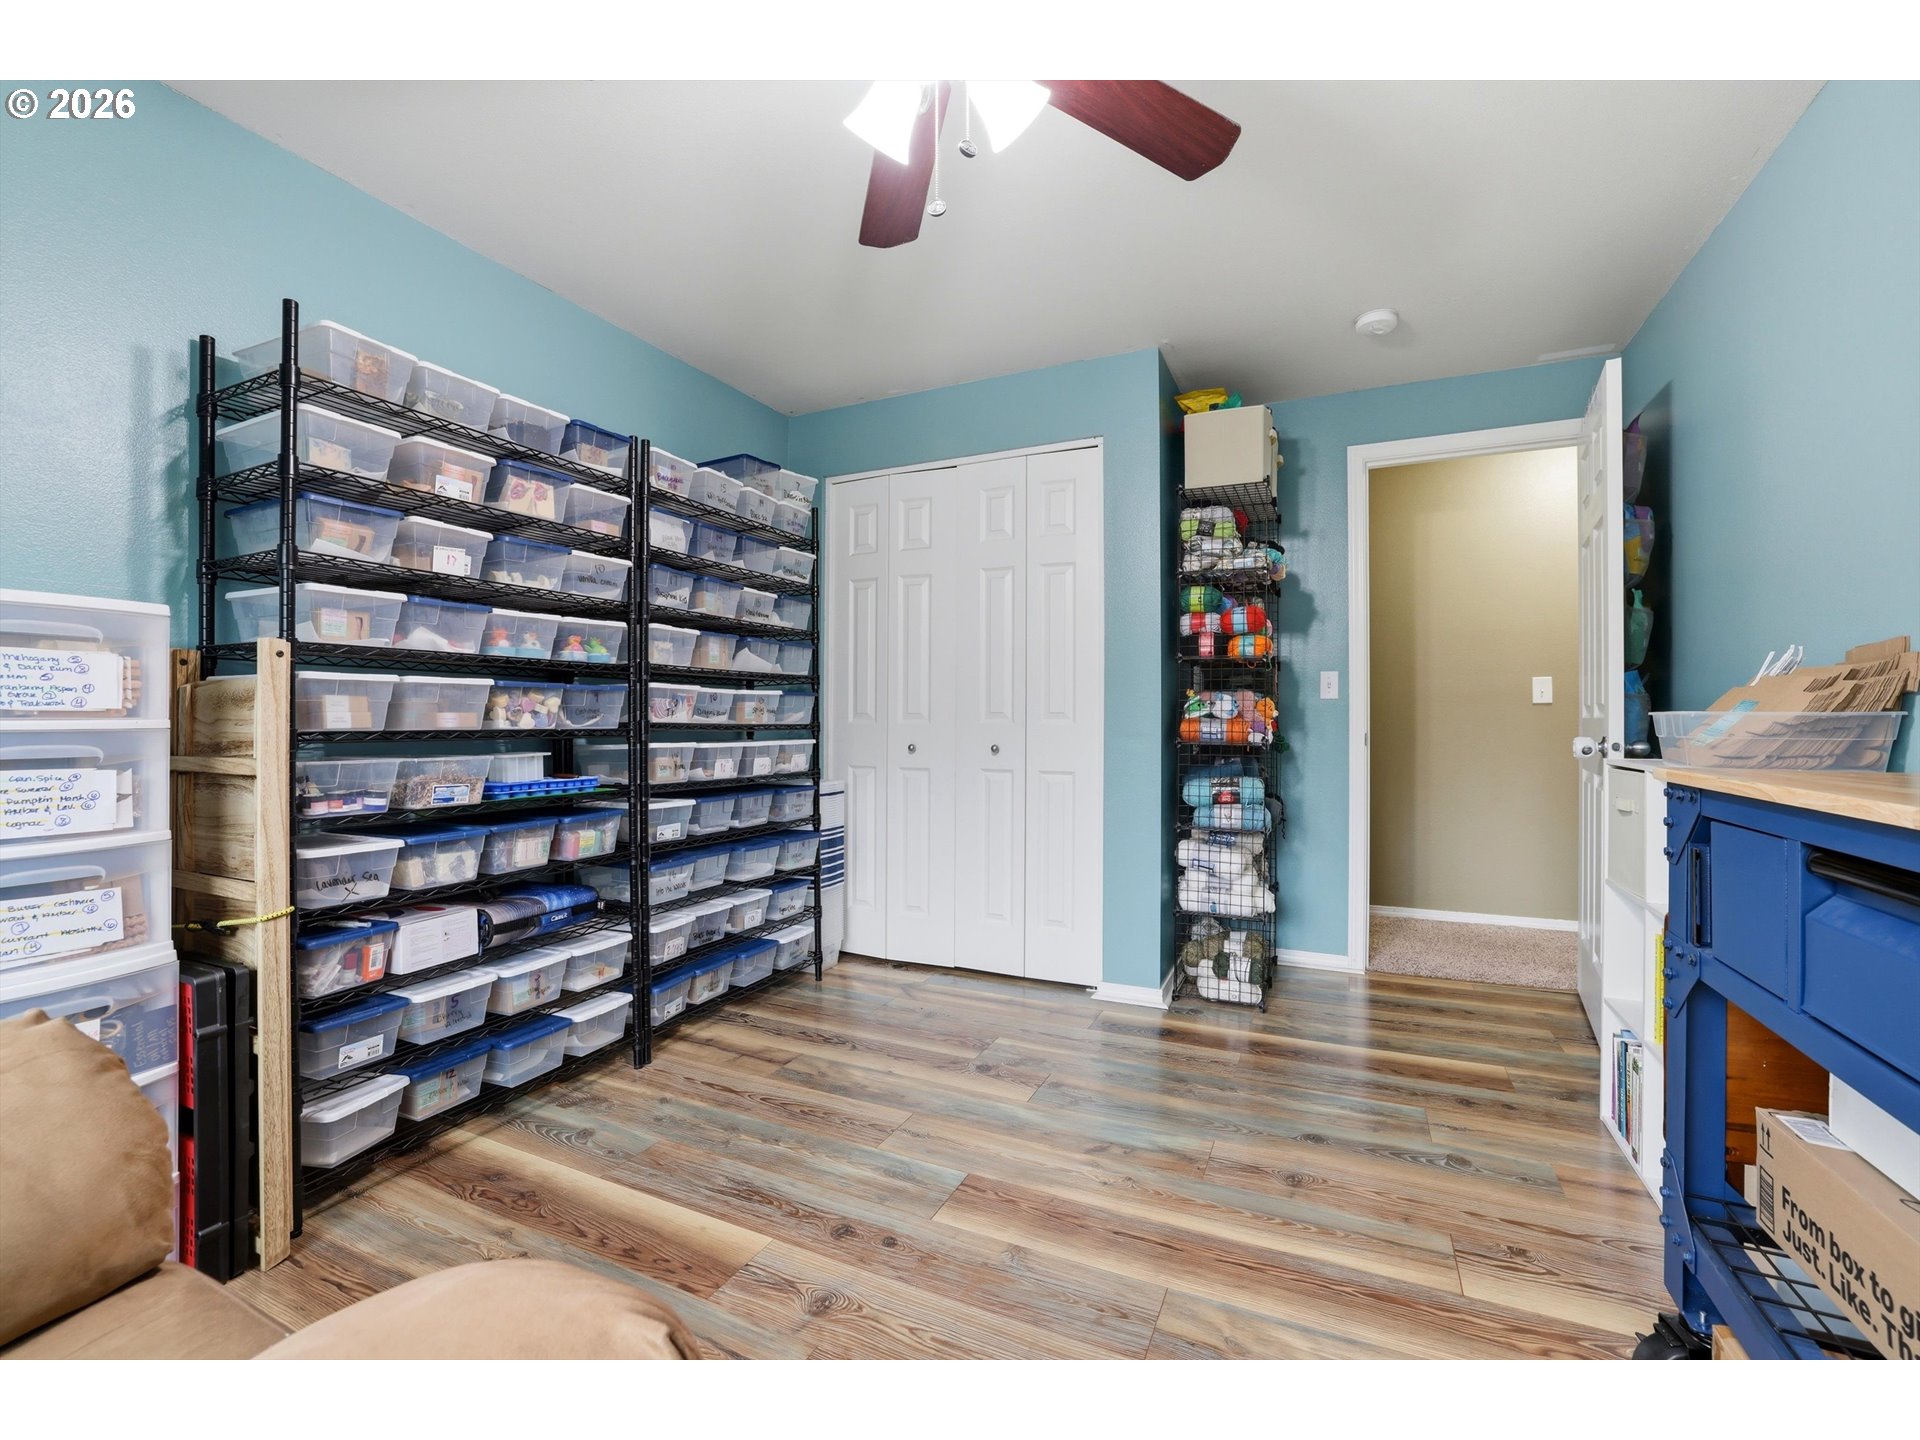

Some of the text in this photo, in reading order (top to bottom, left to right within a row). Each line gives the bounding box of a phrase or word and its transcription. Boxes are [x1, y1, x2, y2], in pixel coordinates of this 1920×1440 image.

[316, 870, 380, 892] Lavender Sea
[1781, 1185, 1825, 1249] From
[1829, 1230, 1866, 1289] box
[1869, 1271, 1894, 1314] to
[1782, 1220, 1920, 1361] Just. Like. Th
